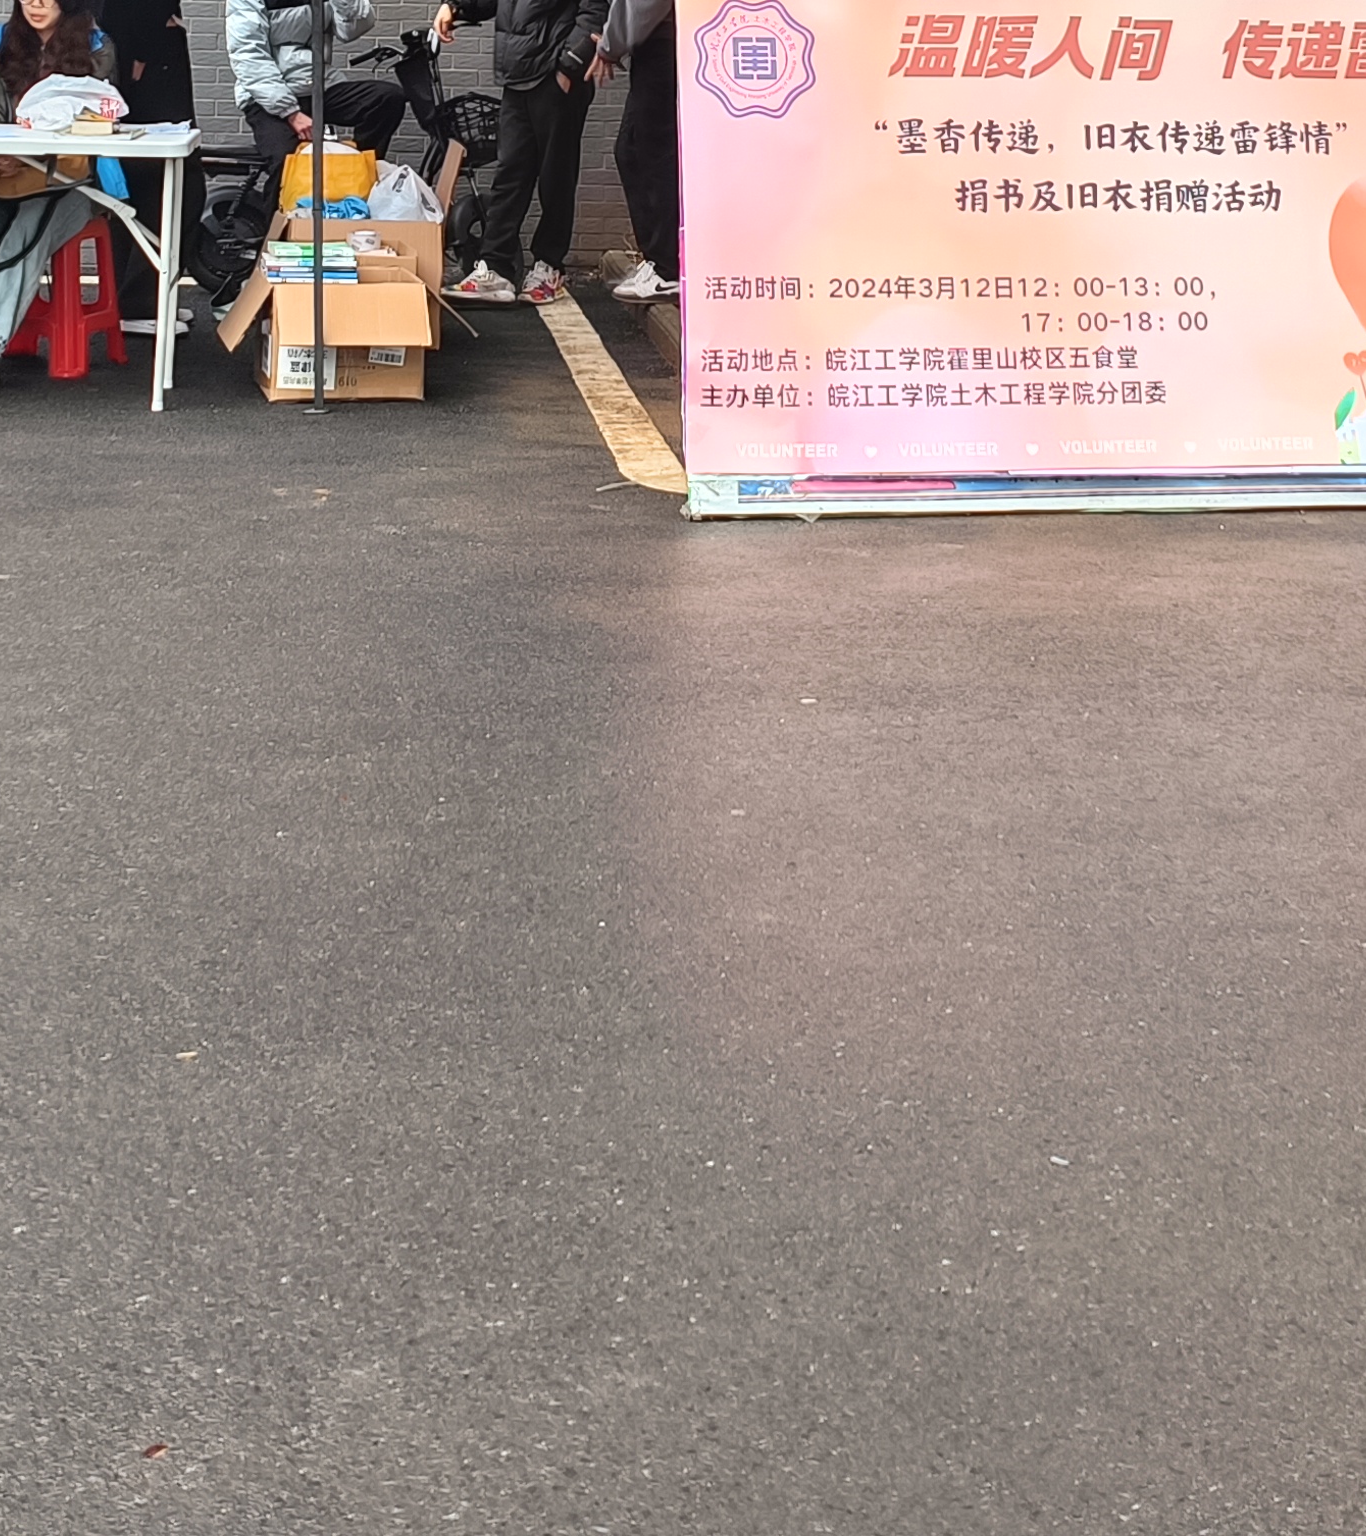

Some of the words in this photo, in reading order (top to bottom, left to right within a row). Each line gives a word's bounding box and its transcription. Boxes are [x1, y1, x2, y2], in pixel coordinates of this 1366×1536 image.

[888, 14, 1174, 81] 温暖人间
[954, 178, 1282, 213] 捐书及旧衣捐赠活动
[737, 443, 838, 459] VOLUNTEER
[898, 441, 999, 457] VOLUNTEER
[1059, 439, 1158, 454] VOLUNTEER
[1217, 436, 1313, 451] VOLUNTEER
